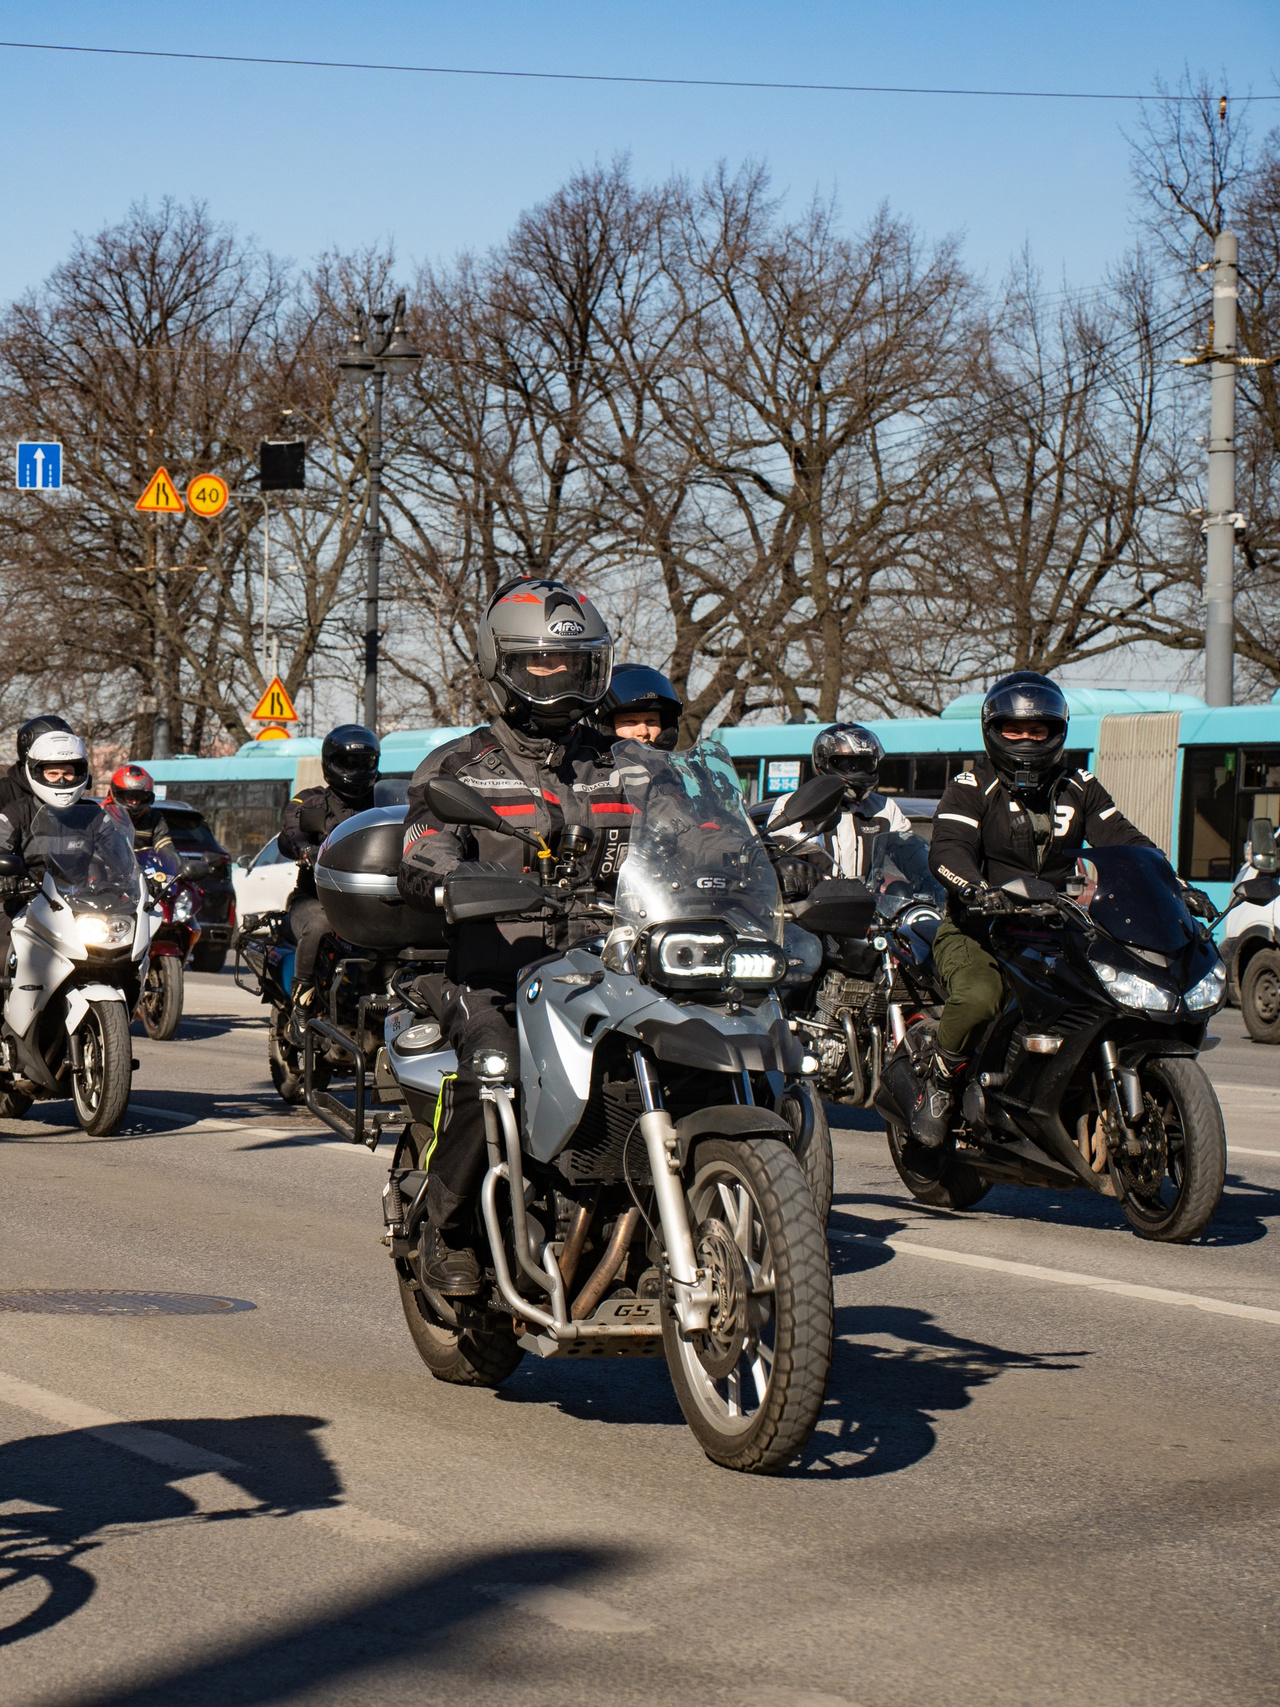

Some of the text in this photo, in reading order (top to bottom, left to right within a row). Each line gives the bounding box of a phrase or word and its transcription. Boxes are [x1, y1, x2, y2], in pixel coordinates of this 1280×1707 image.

[196, 488, 219, 503] 40
[581, 781, 612, 792] DIMOX
[696, 877, 726, 889] GS
[614, 1304, 654, 1317] GS
